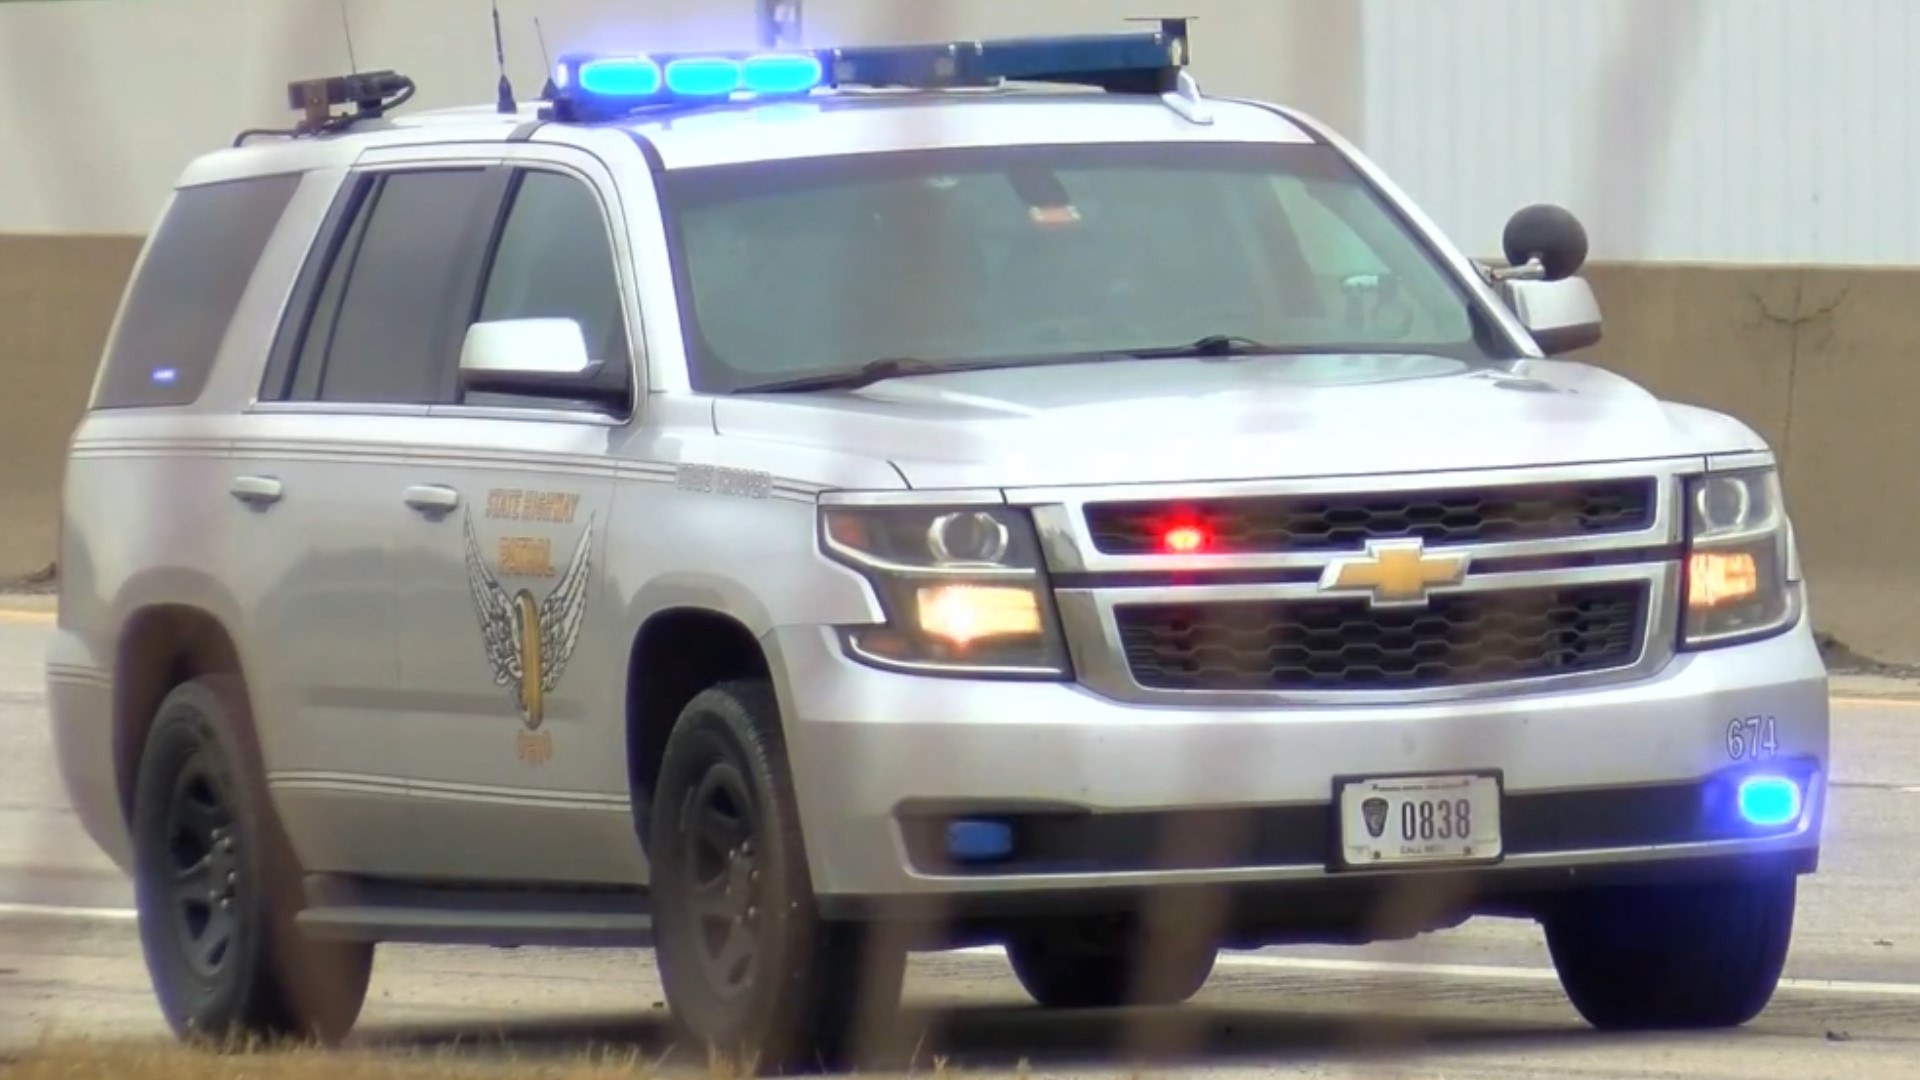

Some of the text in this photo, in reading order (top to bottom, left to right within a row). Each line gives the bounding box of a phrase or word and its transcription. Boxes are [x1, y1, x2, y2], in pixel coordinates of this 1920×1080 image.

[484, 488, 580, 523] STATE HIGHWAY
[1726, 715, 1778, 760] 674
[1401, 799, 1470, 841] 0838
